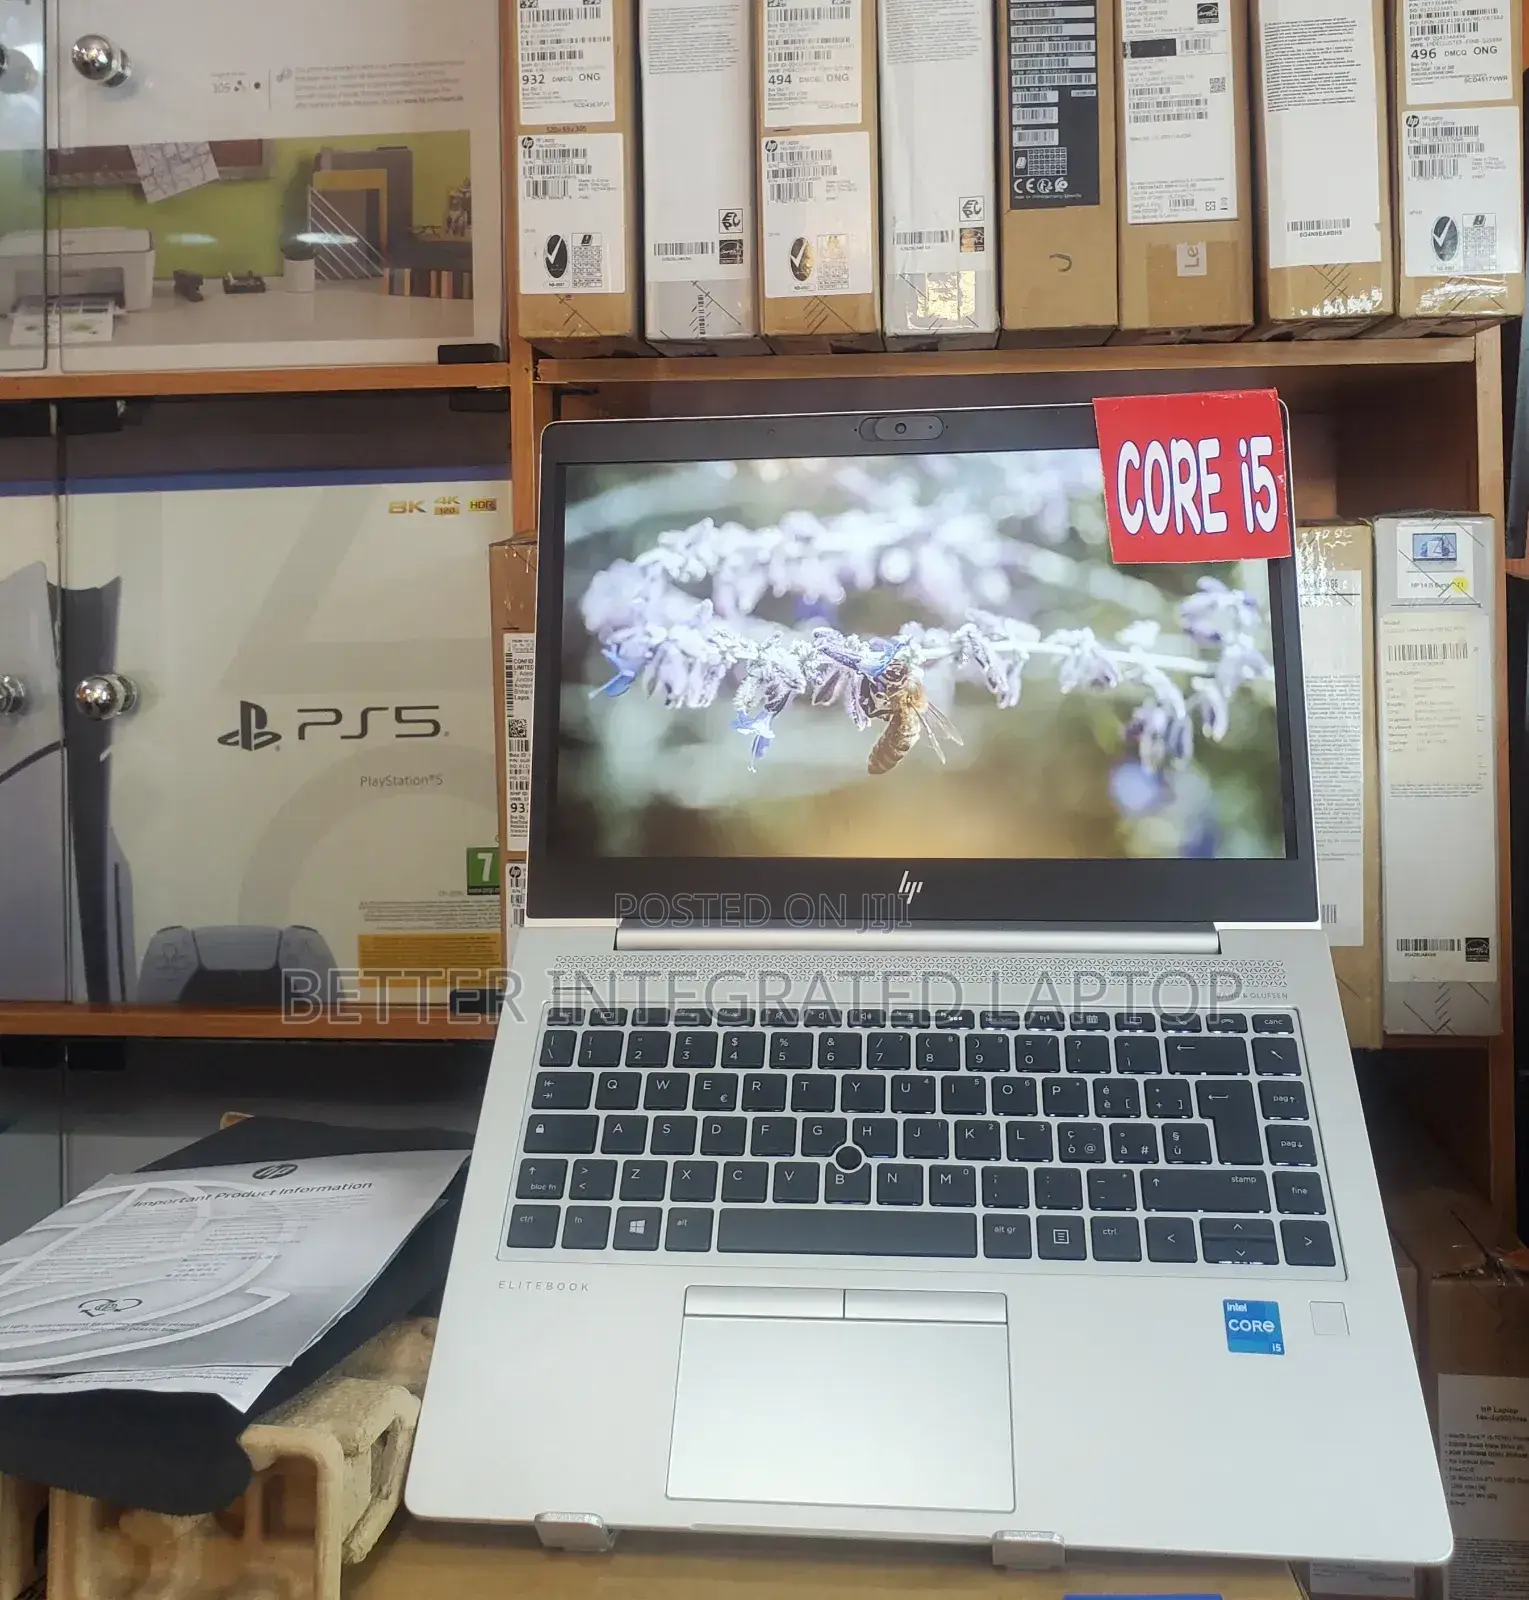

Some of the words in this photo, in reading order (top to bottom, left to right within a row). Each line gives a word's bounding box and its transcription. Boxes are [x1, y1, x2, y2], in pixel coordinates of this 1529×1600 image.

[1410, 48, 1437, 60] 496
[1473, 46, 1498, 55] ONG
[522, 74, 546, 84] 932
[578, 72, 601, 81] ONG
[768, 74, 792, 85] 494
[826, 73, 850, 82] ONG
[1117, 437, 1228, 535] CORE
[1238, 435, 1279, 534] i5
[434, 496, 461, 505] 4K
[470, 500, 496, 510] HDR
[388, 500, 426, 514] 8K
[297, 705, 442, 740] PS5
[477, 852, 494, 882] 7
[731, 1037, 738, 1046] $
[779, 1038, 789, 1047] %
[827, 1038, 835, 1046] &
[634, 1051, 642, 1059] 2
[682, 1052, 690, 1060] 3
[730, 1052, 738, 1060] 4
[779, 1052, 786, 1060] 5
[827, 1053, 835, 1061] 6
[876, 1053, 884, 1061] 7
[926, 1054, 934, 1062] 8
[975, 1055, 983, 1063] 9
[607, 1080, 618, 1090] Q
[656, 1080, 670, 1090] W
[703, 1081, 712, 1090] E
[752, 1082, 761, 1090] R
[801, 1082, 809, 1091] T
[851, 1082, 861, 1092] Y
[901, 1083, 910, 1092] U
[1002, 1084, 1013, 1094] O
[1053, 1086, 1061, 1095] P
[1273, 1095, 1289, 1103] pag
[612, 1124, 623, 1133] A
[662, 1124, 671, 1134] S
[711, 1124, 722, 1134] D
[761, 1125, 770, 1135] F
[812, 1126, 823, 1135] G
[862, 1126, 872, 1136] H
[913, 1127, 921, 1137] J
[965, 1128, 974, 1138] K
[1016, 1130, 1025, 1140] L
[1084, 1143, 1096, 1154] @
[1281, 1140, 1296, 1148] pag
[1141, 1146, 1149, 1154] #
[631, 1169, 640, 1179] Z
[682, 1170, 691, 1180] X
[733, 1170, 742, 1180] C
[784, 1171, 794, 1181] V
[888, 1173, 898, 1183] N
[941, 1174, 952, 1184] M
[836, 1175, 845, 1184] B
[1231, 1176, 1256, 1184] stamp
[133, 1194, 212, 1207] Important
[216, 1189, 277, 1200] Product
[279, 1182, 373, 1196] Information
[498, 1280, 589, 1292] ELITEBOOK
[1272, 1343, 1282, 1352] i5
